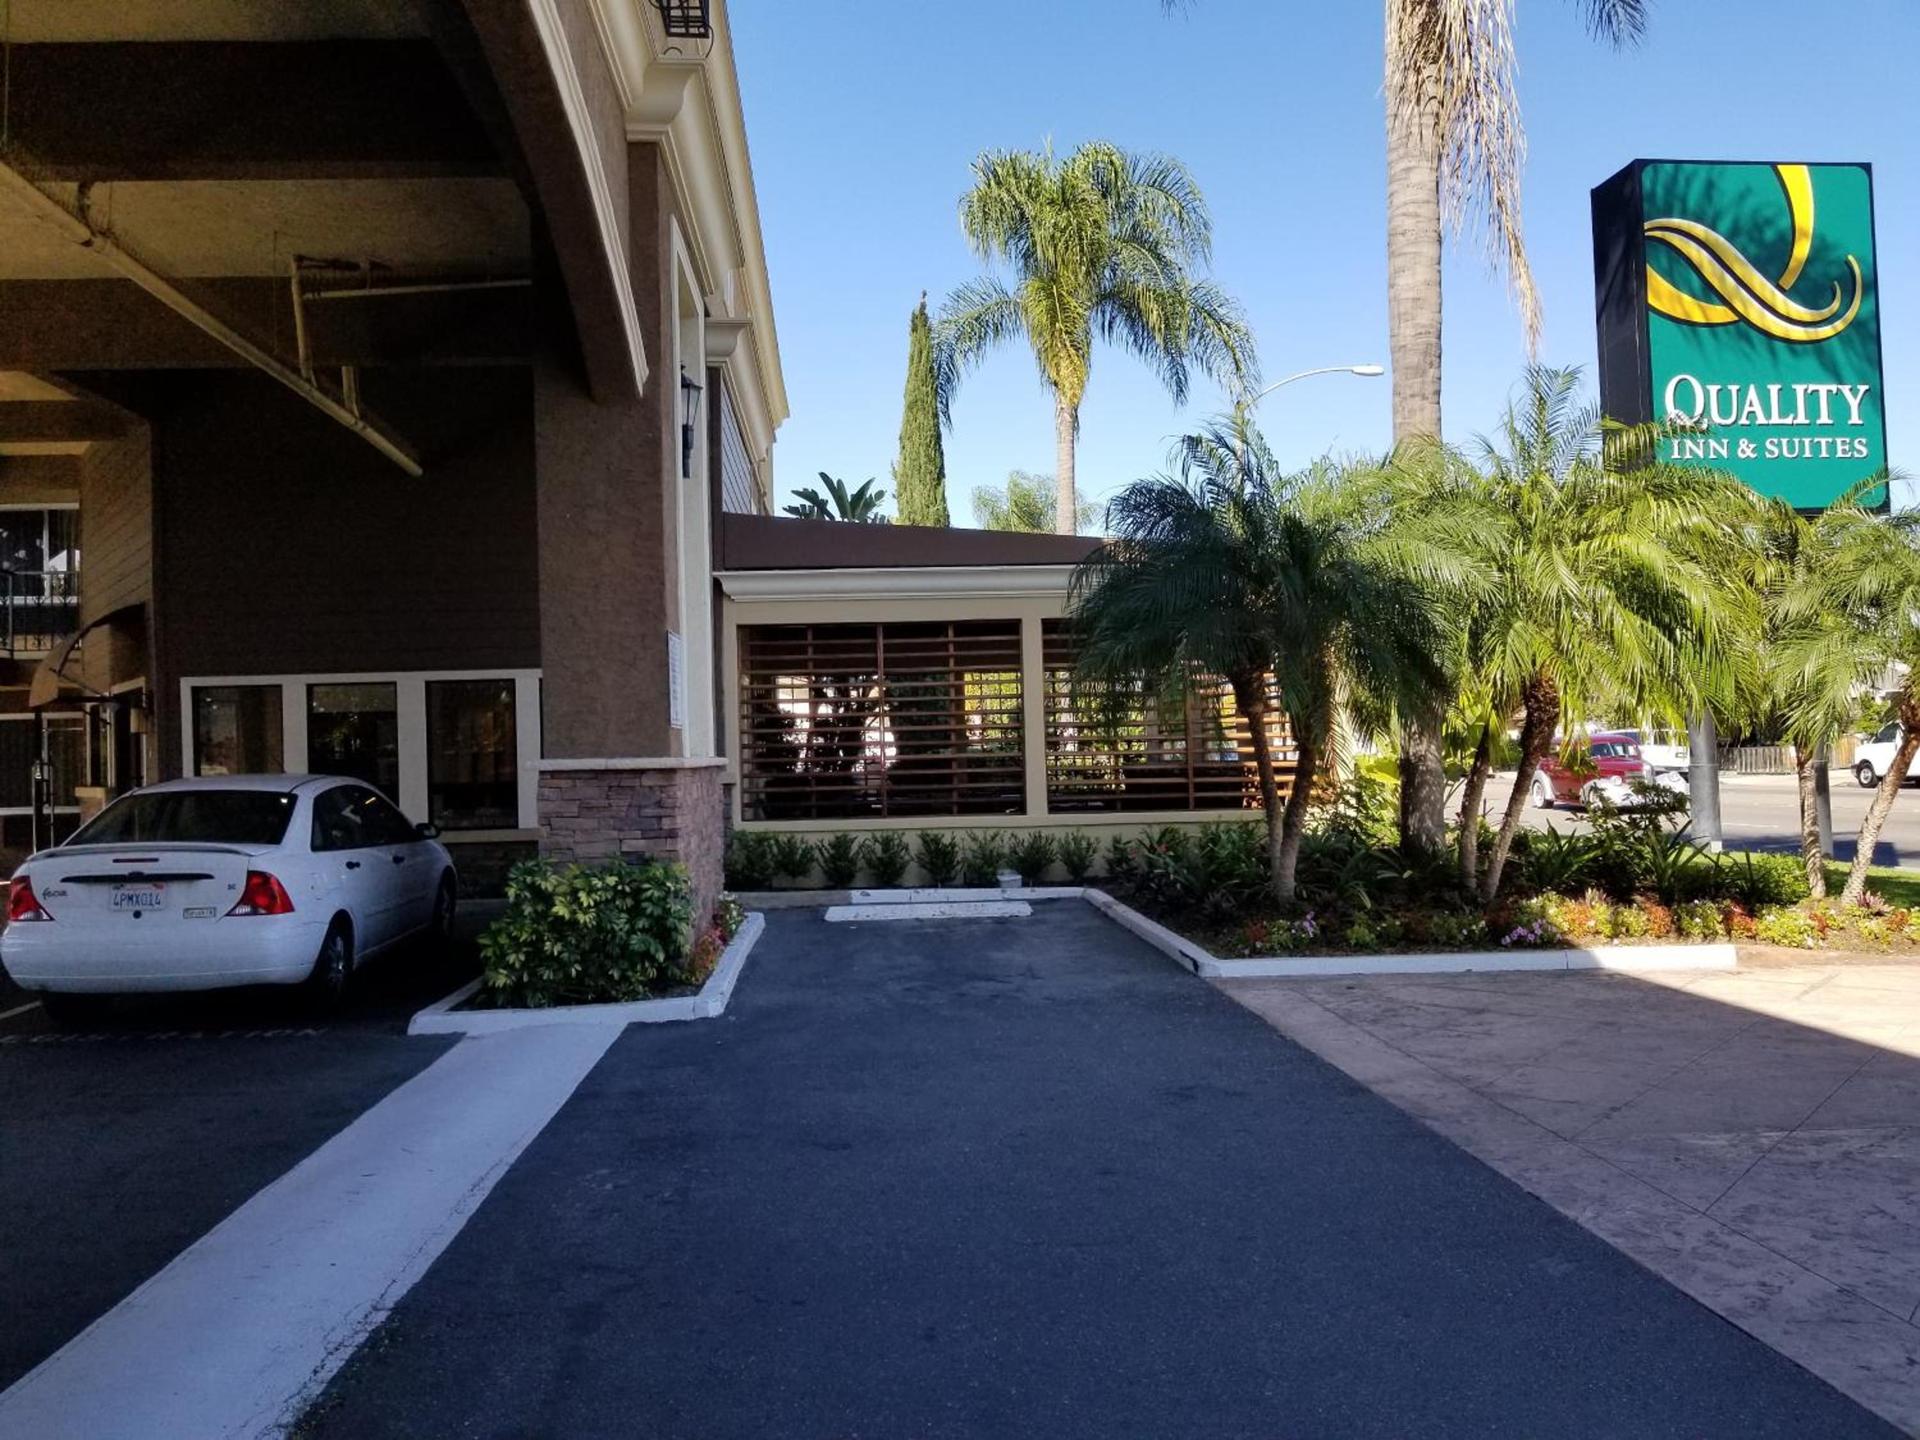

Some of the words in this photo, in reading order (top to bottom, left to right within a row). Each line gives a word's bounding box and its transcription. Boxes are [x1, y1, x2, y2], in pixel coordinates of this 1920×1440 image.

[1664, 374, 1869, 431] QUALITY
[1671, 438, 1729, 459] INN
[1737, 438, 1758, 459] &
[1765, 437, 1868, 459] SUITES
